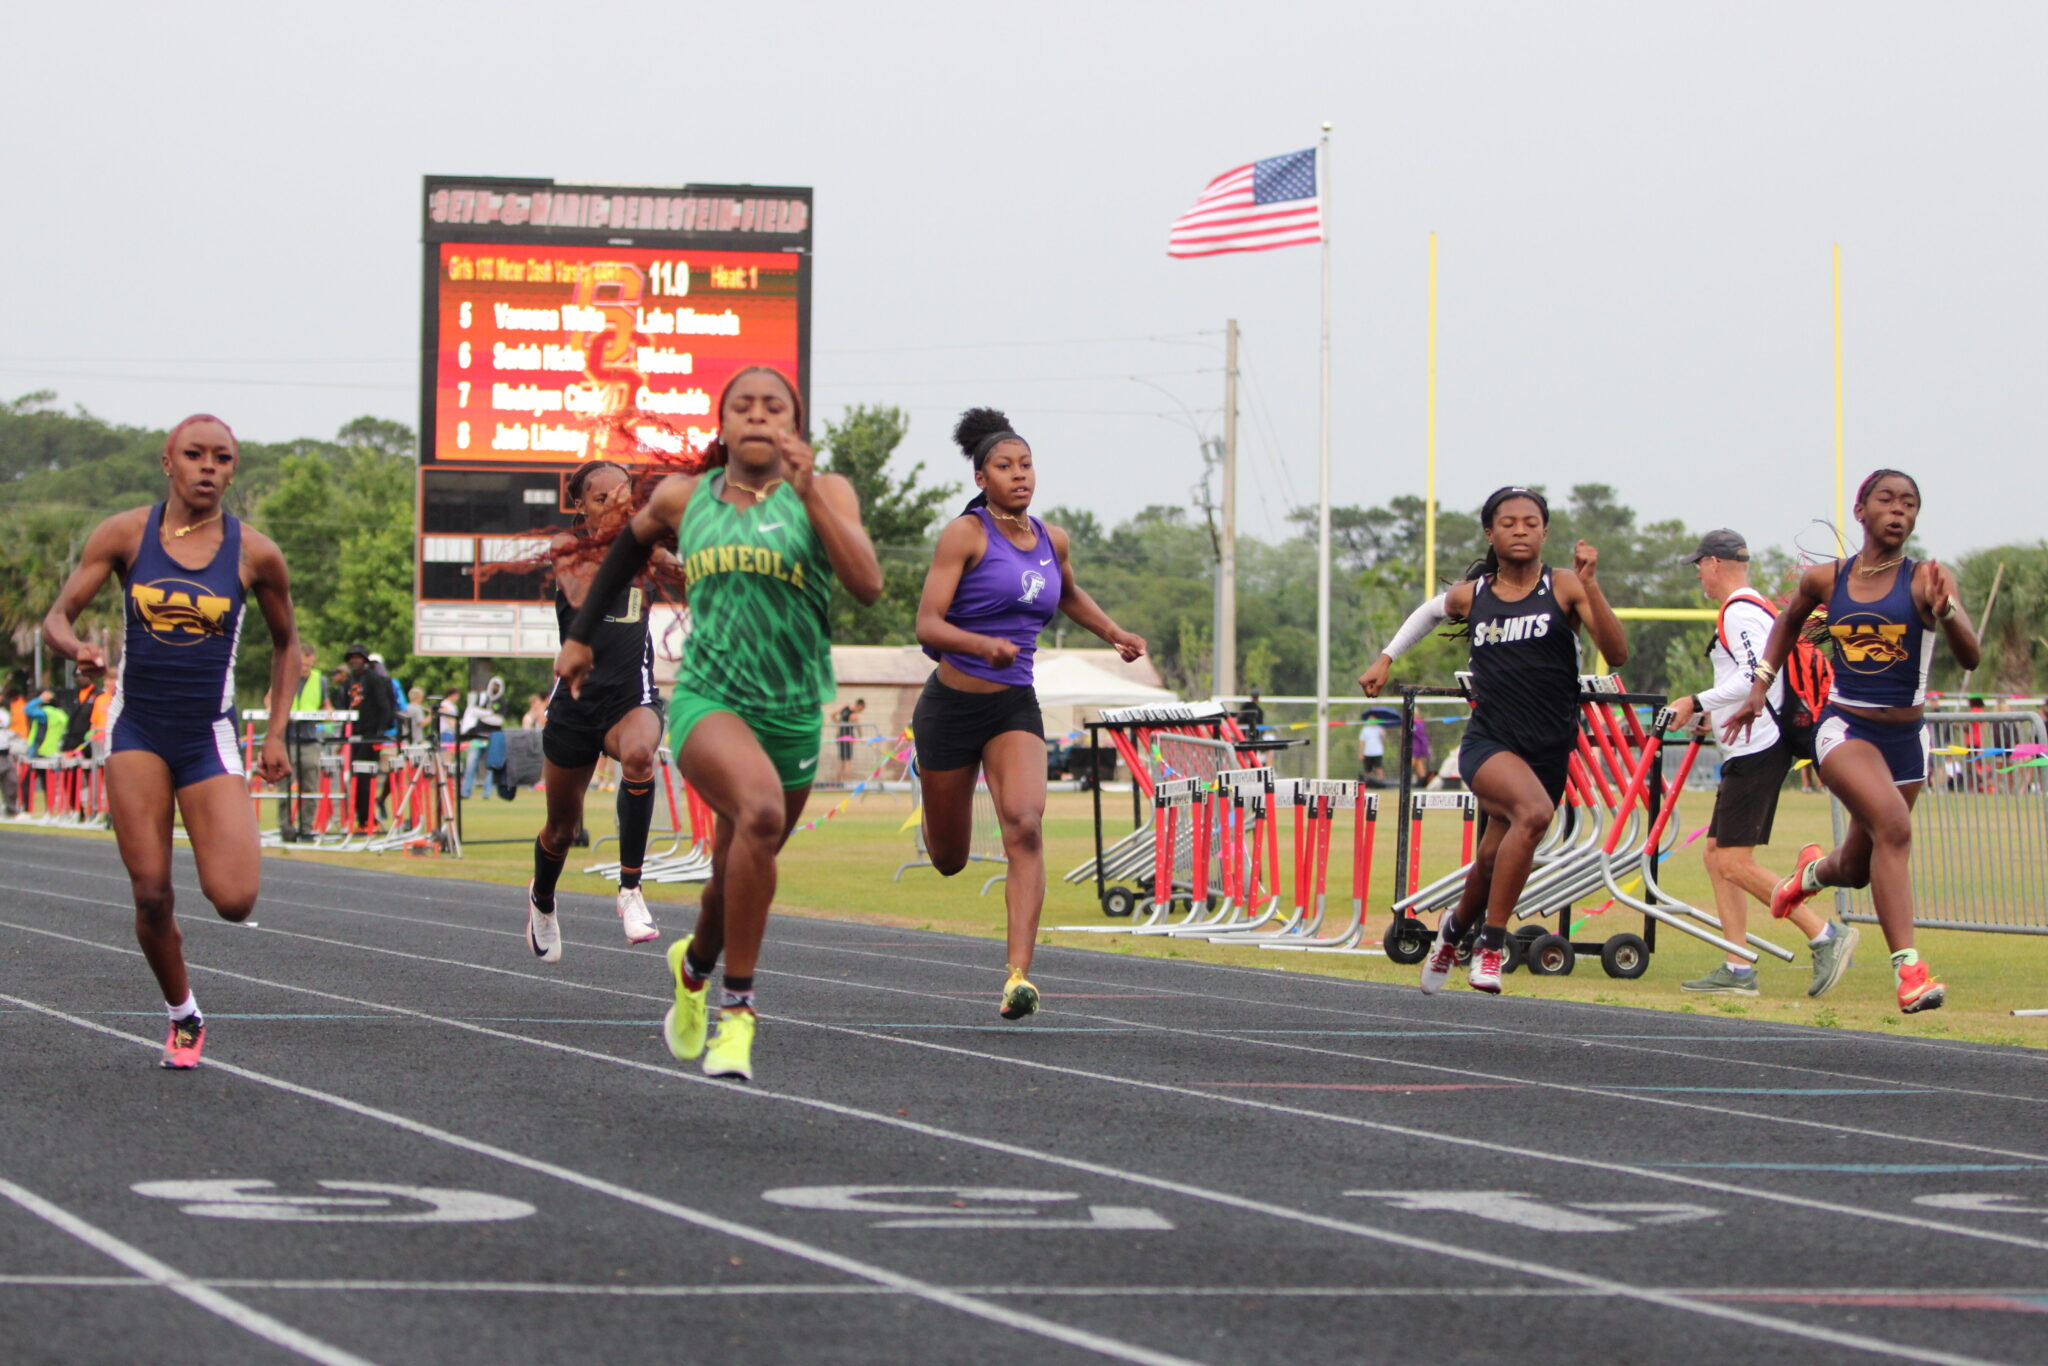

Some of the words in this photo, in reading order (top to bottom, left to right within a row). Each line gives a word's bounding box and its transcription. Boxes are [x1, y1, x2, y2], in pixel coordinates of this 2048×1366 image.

[609, 195, 742, 231] BERNSTEIN
[740, 199, 807, 233] FIELD
[649, 260, 690, 297] 11.0
[459, 301, 472, 329] 5
[636, 307, 674, 334] Lake
[458, 341, 471, 369] 6
[457, 381, 471, 408] 7
[457, 421, 470, 449] 8
